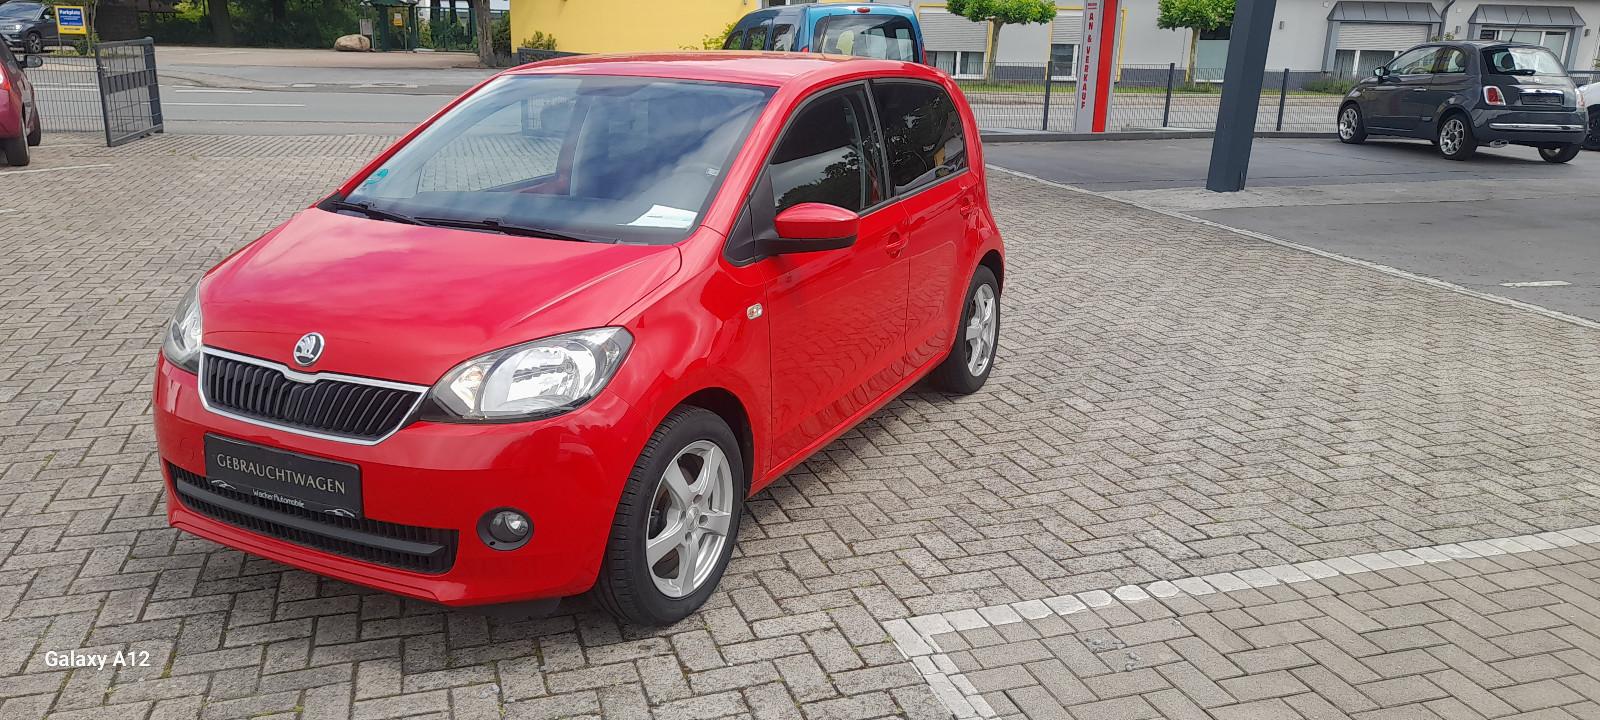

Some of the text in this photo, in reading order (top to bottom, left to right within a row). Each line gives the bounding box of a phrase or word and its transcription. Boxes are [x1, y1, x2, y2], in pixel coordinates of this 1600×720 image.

[1087, 12, 1094, 30] AN
[1081, 46, 1091, 109] VERKAUF
[216, 453, 345, 495] GEBRAUCHTWAGEN
[274, 494, 305, 509] Automobile
